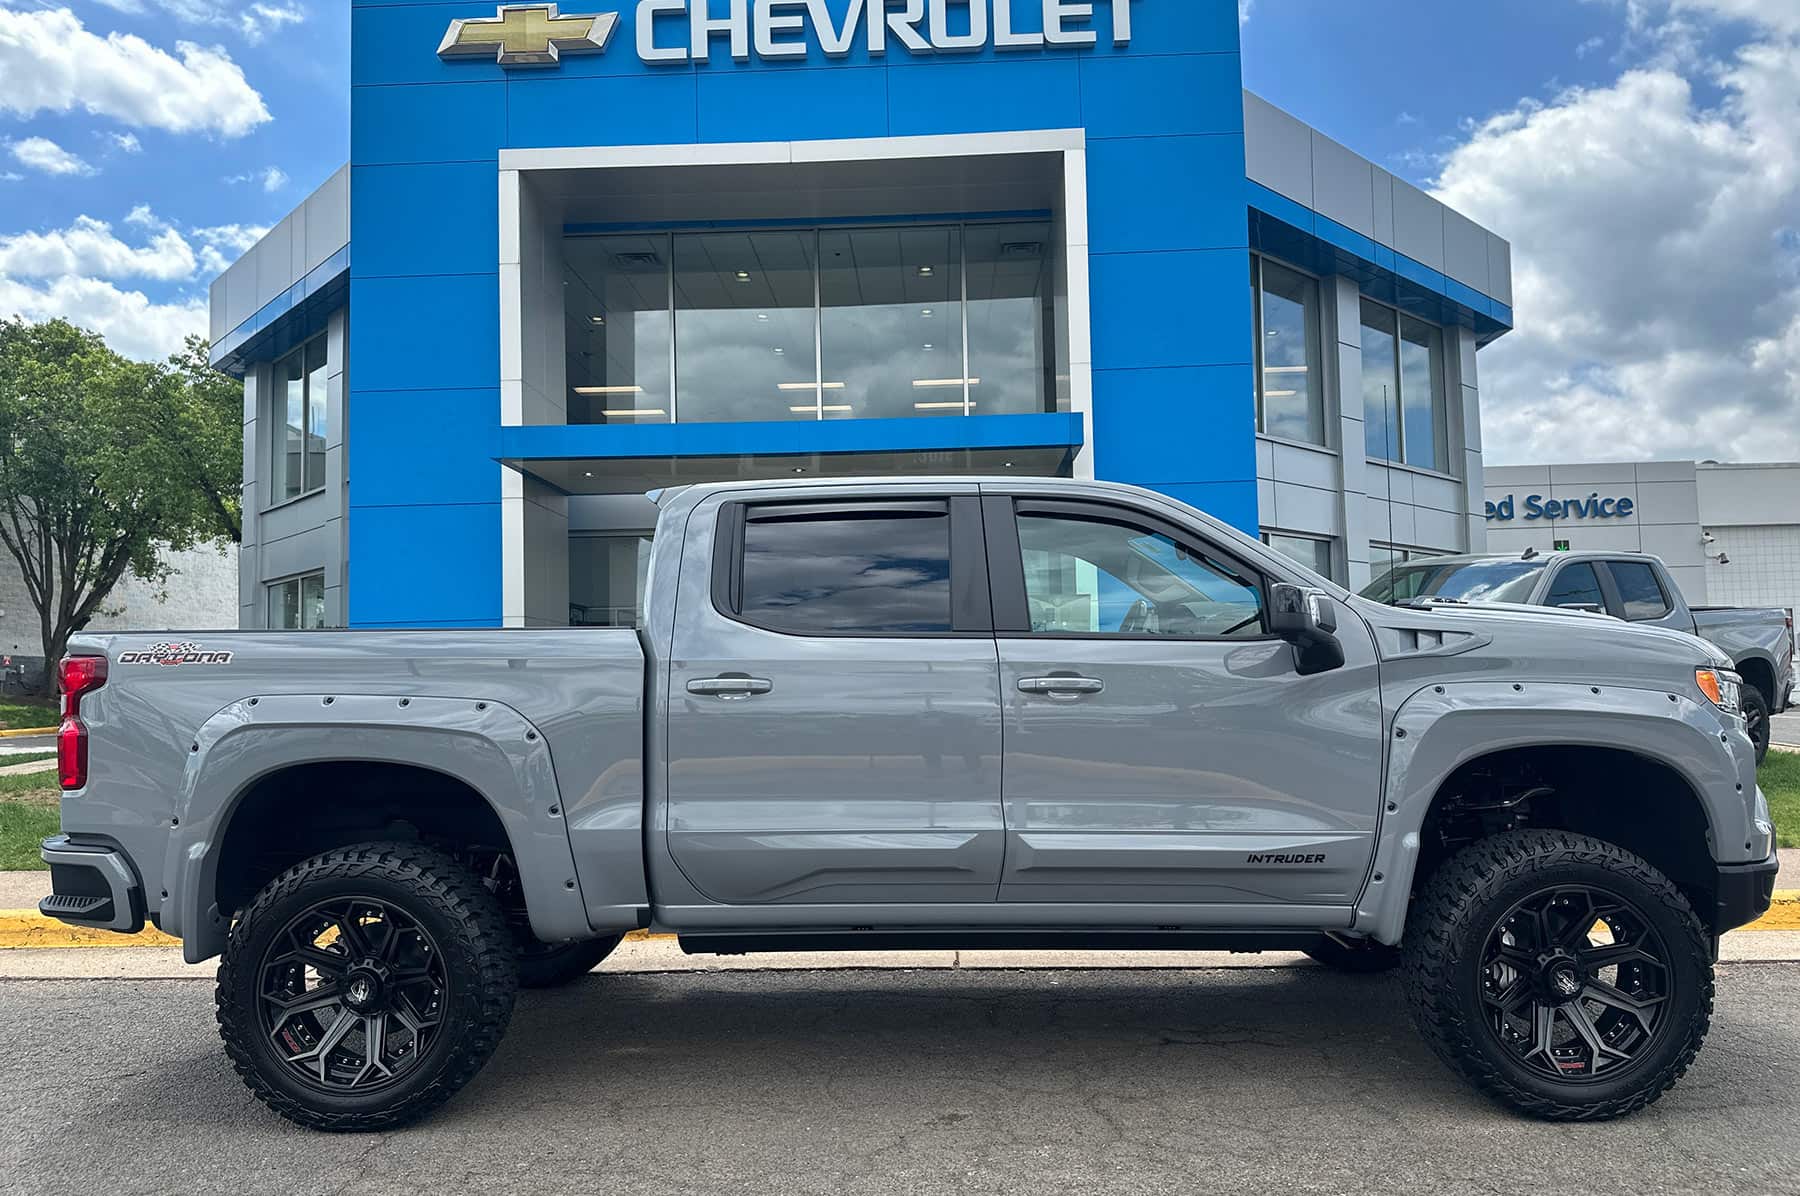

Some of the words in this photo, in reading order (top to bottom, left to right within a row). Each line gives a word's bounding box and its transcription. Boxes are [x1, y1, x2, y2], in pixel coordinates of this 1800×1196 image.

[1524, 492, 1634, 520] Service
[119, 651, 232, 664] DAYTONA
[1246, 854, 1326, 864] INTRUDER
